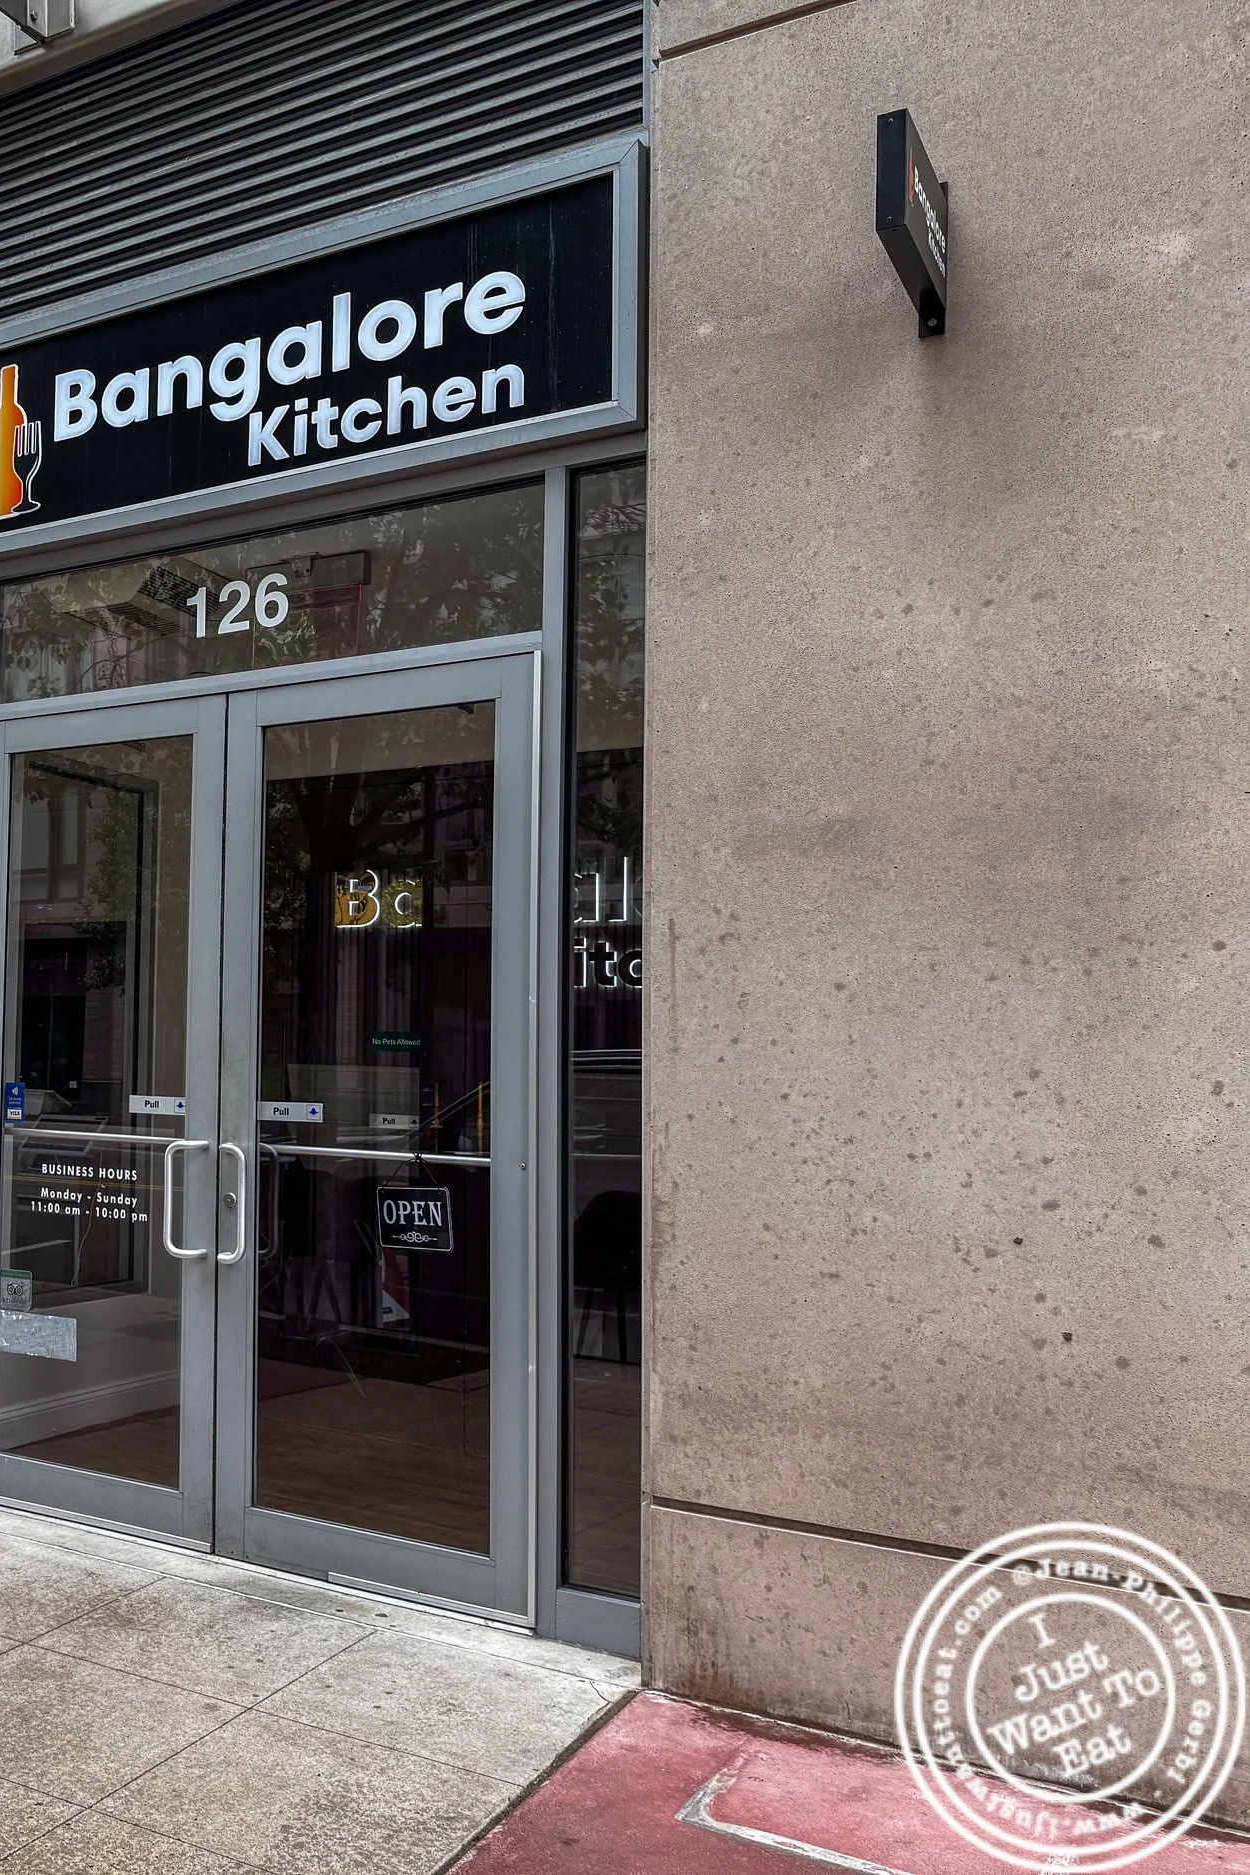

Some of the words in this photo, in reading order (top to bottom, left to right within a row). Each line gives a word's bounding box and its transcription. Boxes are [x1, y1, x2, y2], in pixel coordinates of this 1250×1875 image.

[914, 166, 945, 254] Bangalore
[928, 228, 945, 278] Kitchen
[53, 270, 526, 442] Bangalore
[247, 363, 525, 466] Kitchen
[185, 572, 290, 639] 126
[372, 1037, 382, 1046] No
[382, 1037, 396, 1046] Pets
[397, 1037, 421, 1047] Allowed
[144, 1099, 160, 1109] Pull
[273, 1107, 290, 1117] Pull
[382, 1117, 397, 1126] Pull
[41, 1163, 94, 1178] BUSINESS
[99, 1167, 138, 1181] HOURS
[40, 1187, 83, 1203] Monday
[96, 1192, 138, 1208] Sunday
[30, 1200, 60, 1214] 11:00
[64, 1205, 81, 1216] am
[95, 1206, 126, 1219] 10:00
[131, 1212, 148, 1223] pm
[383, 1199, 443, 1227] OPEN
